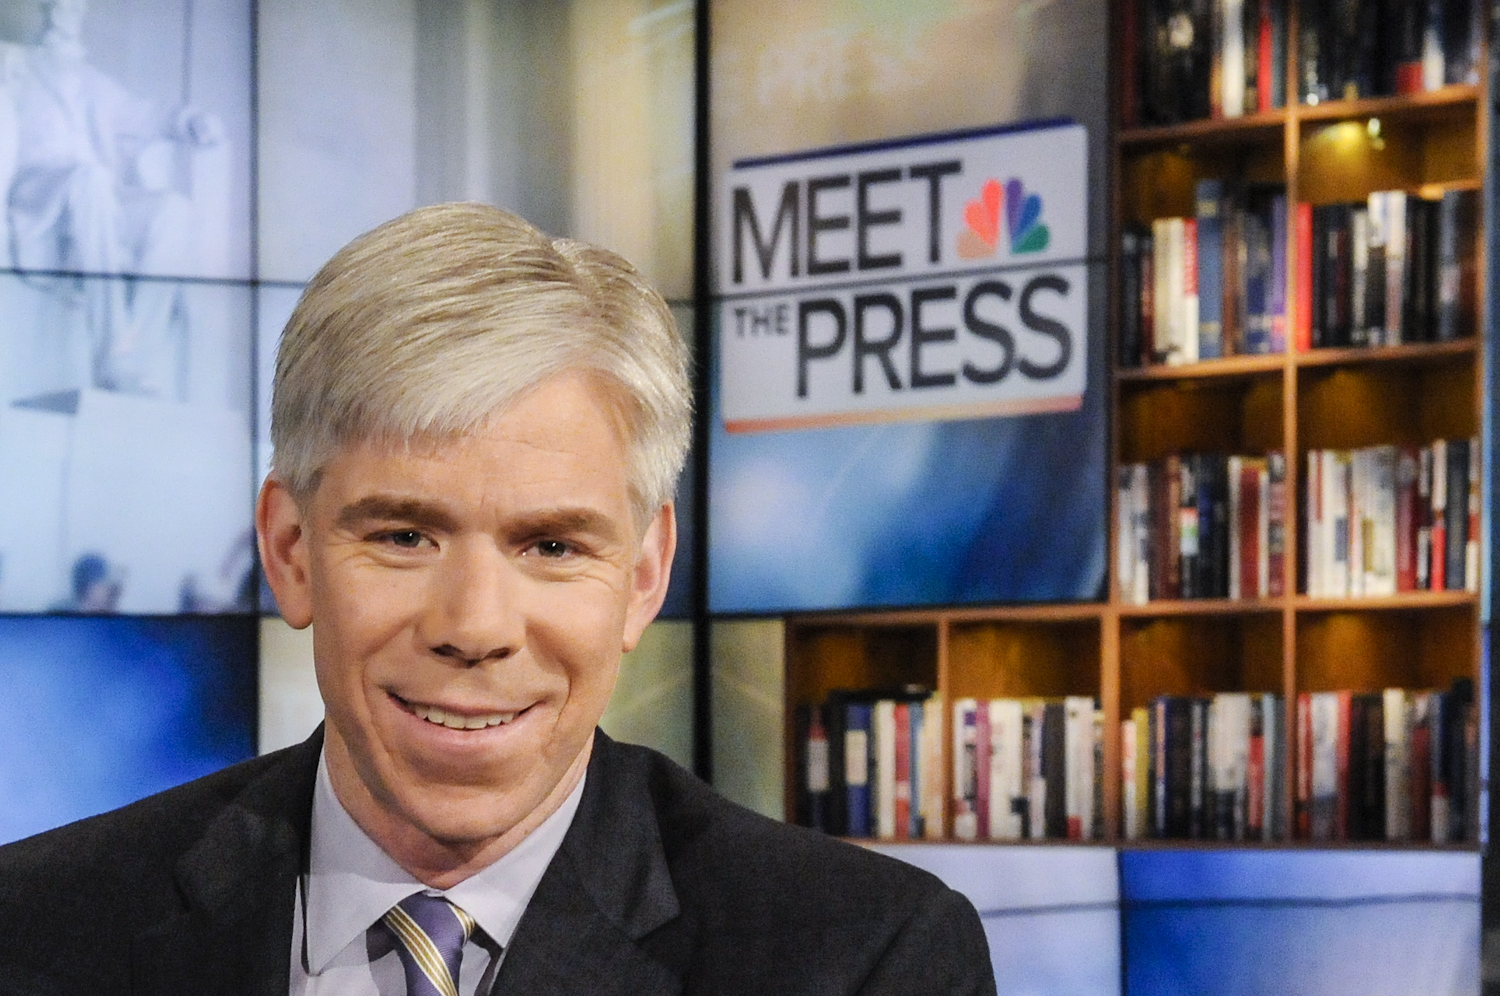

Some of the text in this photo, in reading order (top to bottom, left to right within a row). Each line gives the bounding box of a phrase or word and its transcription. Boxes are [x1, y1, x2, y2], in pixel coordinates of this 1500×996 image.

[732, 159, 962, 285] MEET
[734, 273, 1072, 400] THE PRESS
